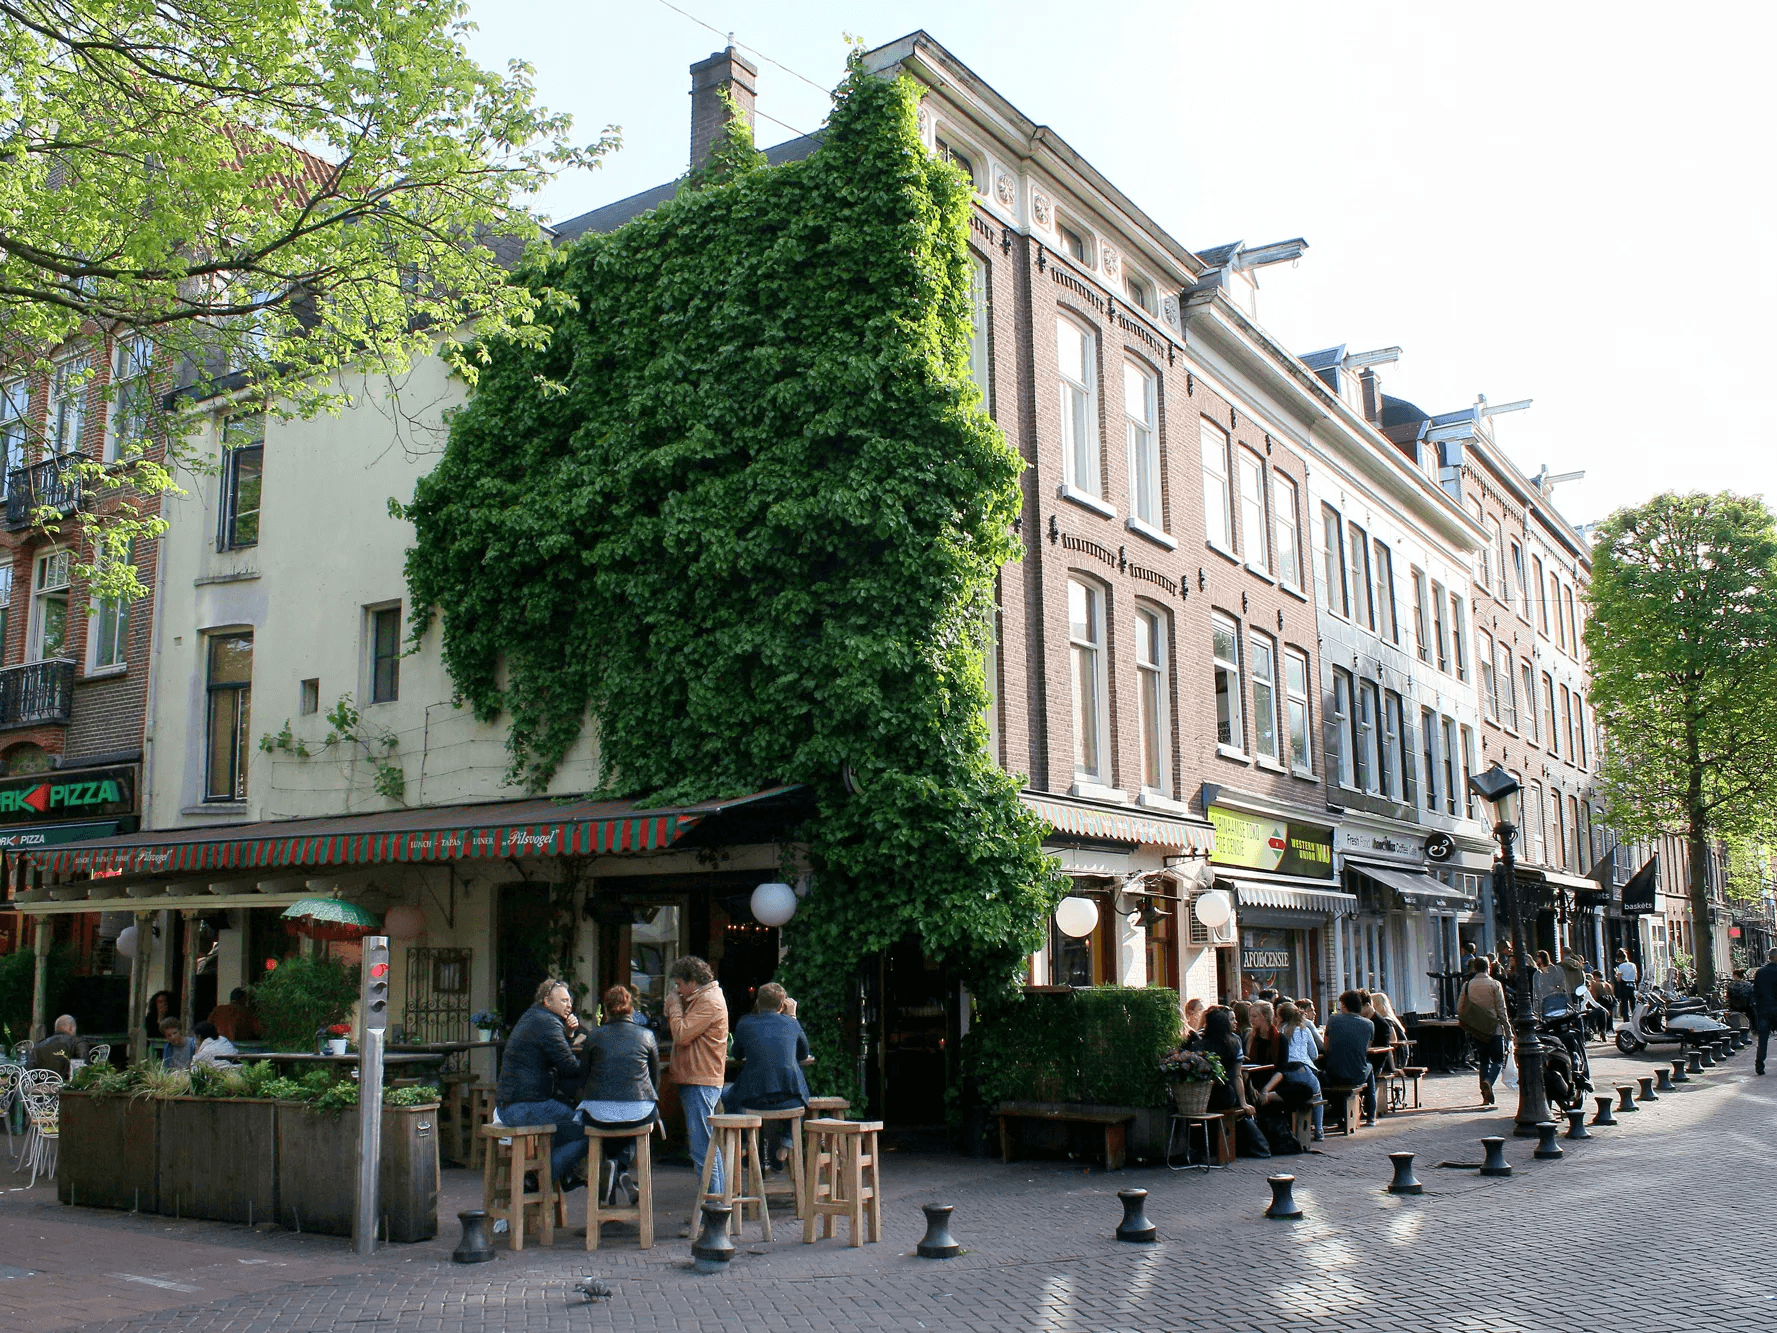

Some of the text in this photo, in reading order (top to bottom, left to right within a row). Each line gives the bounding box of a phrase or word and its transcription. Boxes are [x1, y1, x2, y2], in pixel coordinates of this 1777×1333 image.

[0, 780, 119, 812] RK PIZZA
[0, 834, 45, 847] RK PIZZA
[411, 840, 432, 848] LUNCH
[441, 839, 461, 847] TAPAS
[1290, 838, 1315, 852] WESTERN
[1347, 833, 1360, 847] Fresh
[1624, 902, 1653, 911] baskets
